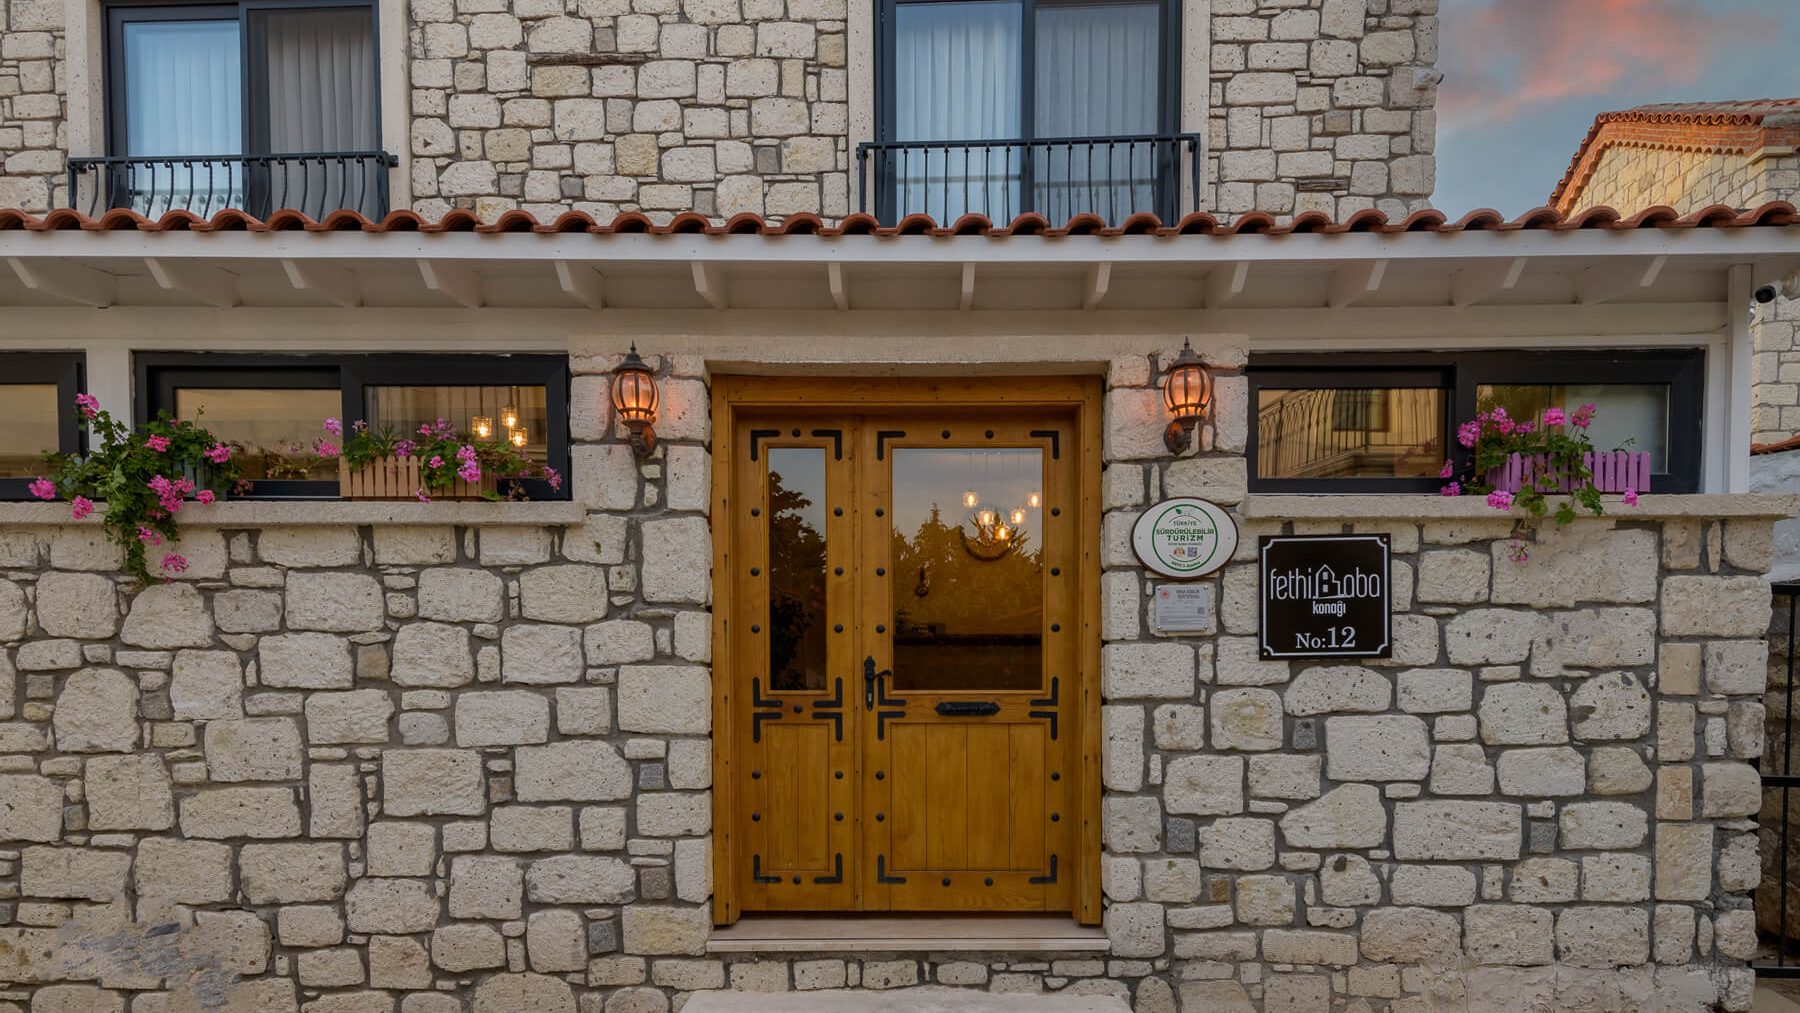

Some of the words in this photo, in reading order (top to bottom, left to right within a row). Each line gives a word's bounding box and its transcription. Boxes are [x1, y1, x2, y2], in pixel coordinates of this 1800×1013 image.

[1156, 527, 1214, 535] SÜRDÜRÜLEBİLİR
[1270, 567, 1312, 600] fethi
[1312, 600, 1346, 617] konağı
[1295, 626, 1356, 649] No:12
